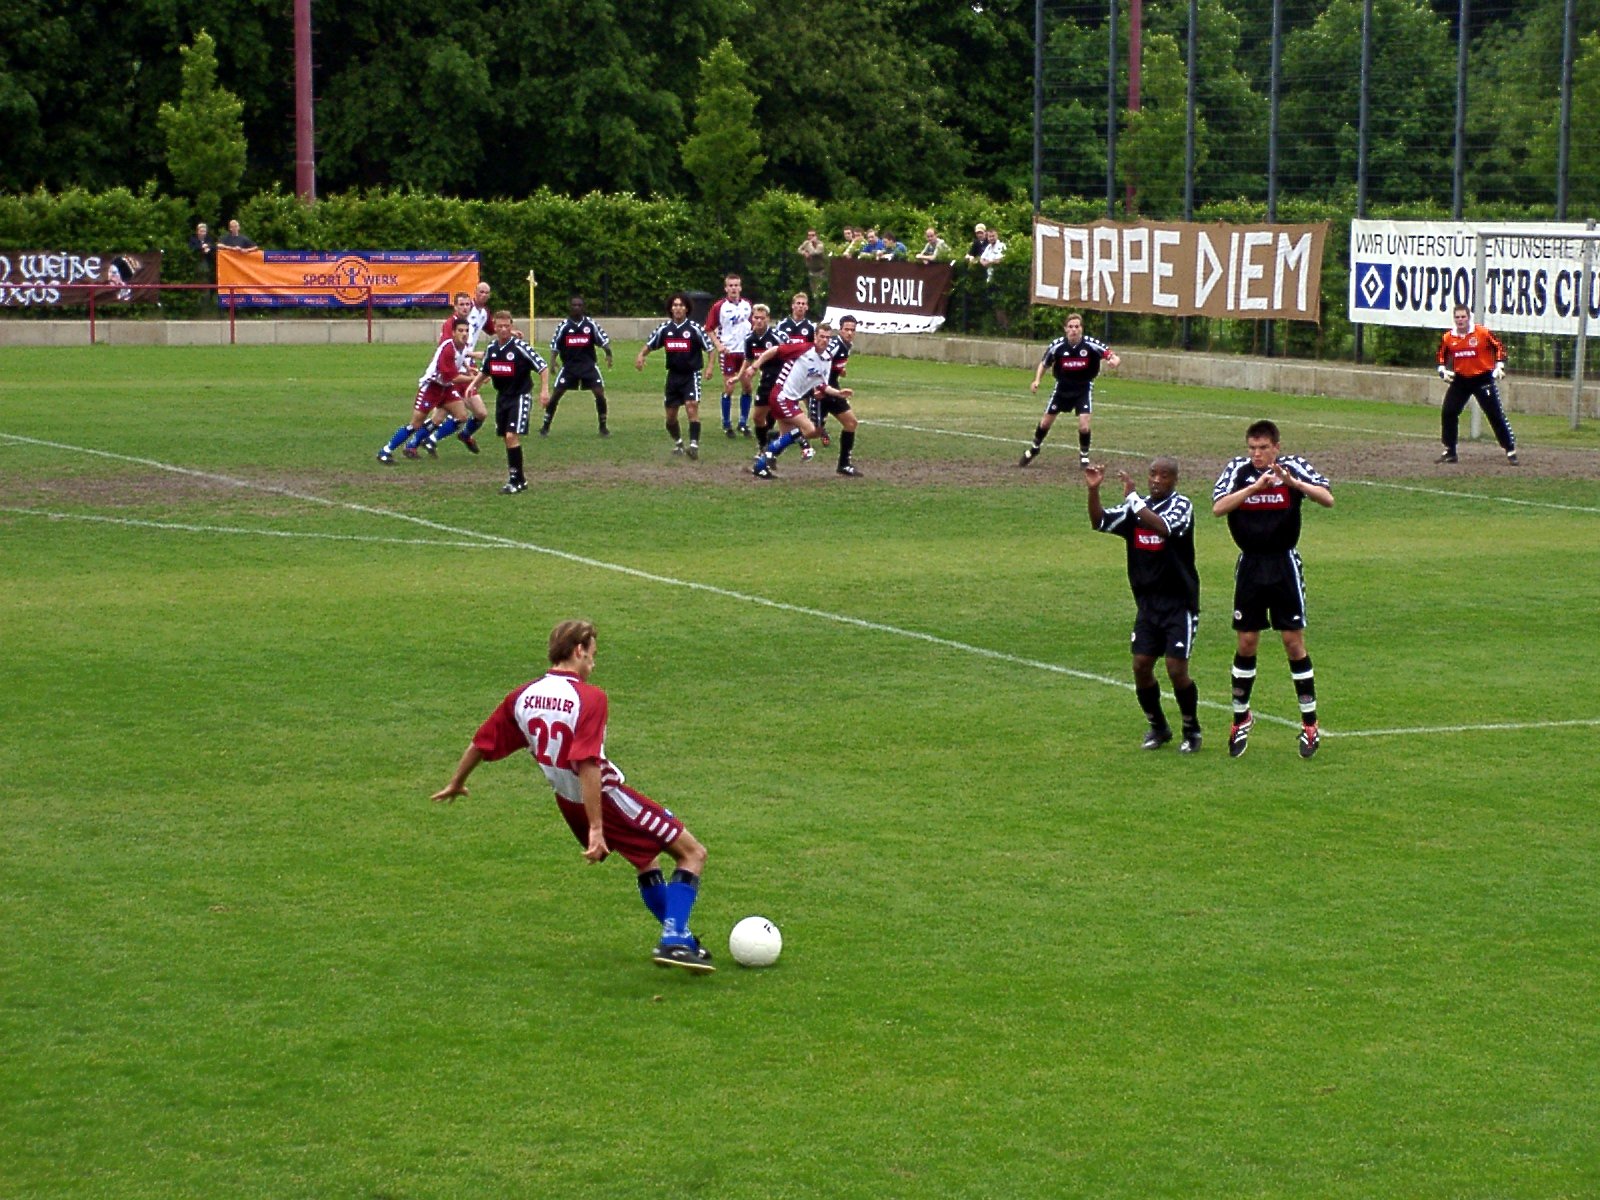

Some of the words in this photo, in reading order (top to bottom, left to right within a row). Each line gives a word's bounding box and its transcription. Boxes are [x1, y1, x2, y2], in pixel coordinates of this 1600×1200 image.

[1356, 233, 1383, 254] WIR
[1387, 230, 1505, 258] UNTERSTÜTEN
[303, 274, 340, 286] SPORT
[363, 274, 399, 287] WERK
[1035, 223, 1181, 306] CARPE
[1194, 231, 1312, 311] DIEM
[856, 276, 877, 304] ST.
[881, 277, 924, 307] PAULI
[1244, 494, 1284, 504] ASTRA
[523, 695, 575, 714] SCHINDLER
[526, 717, 576, 769] 22
